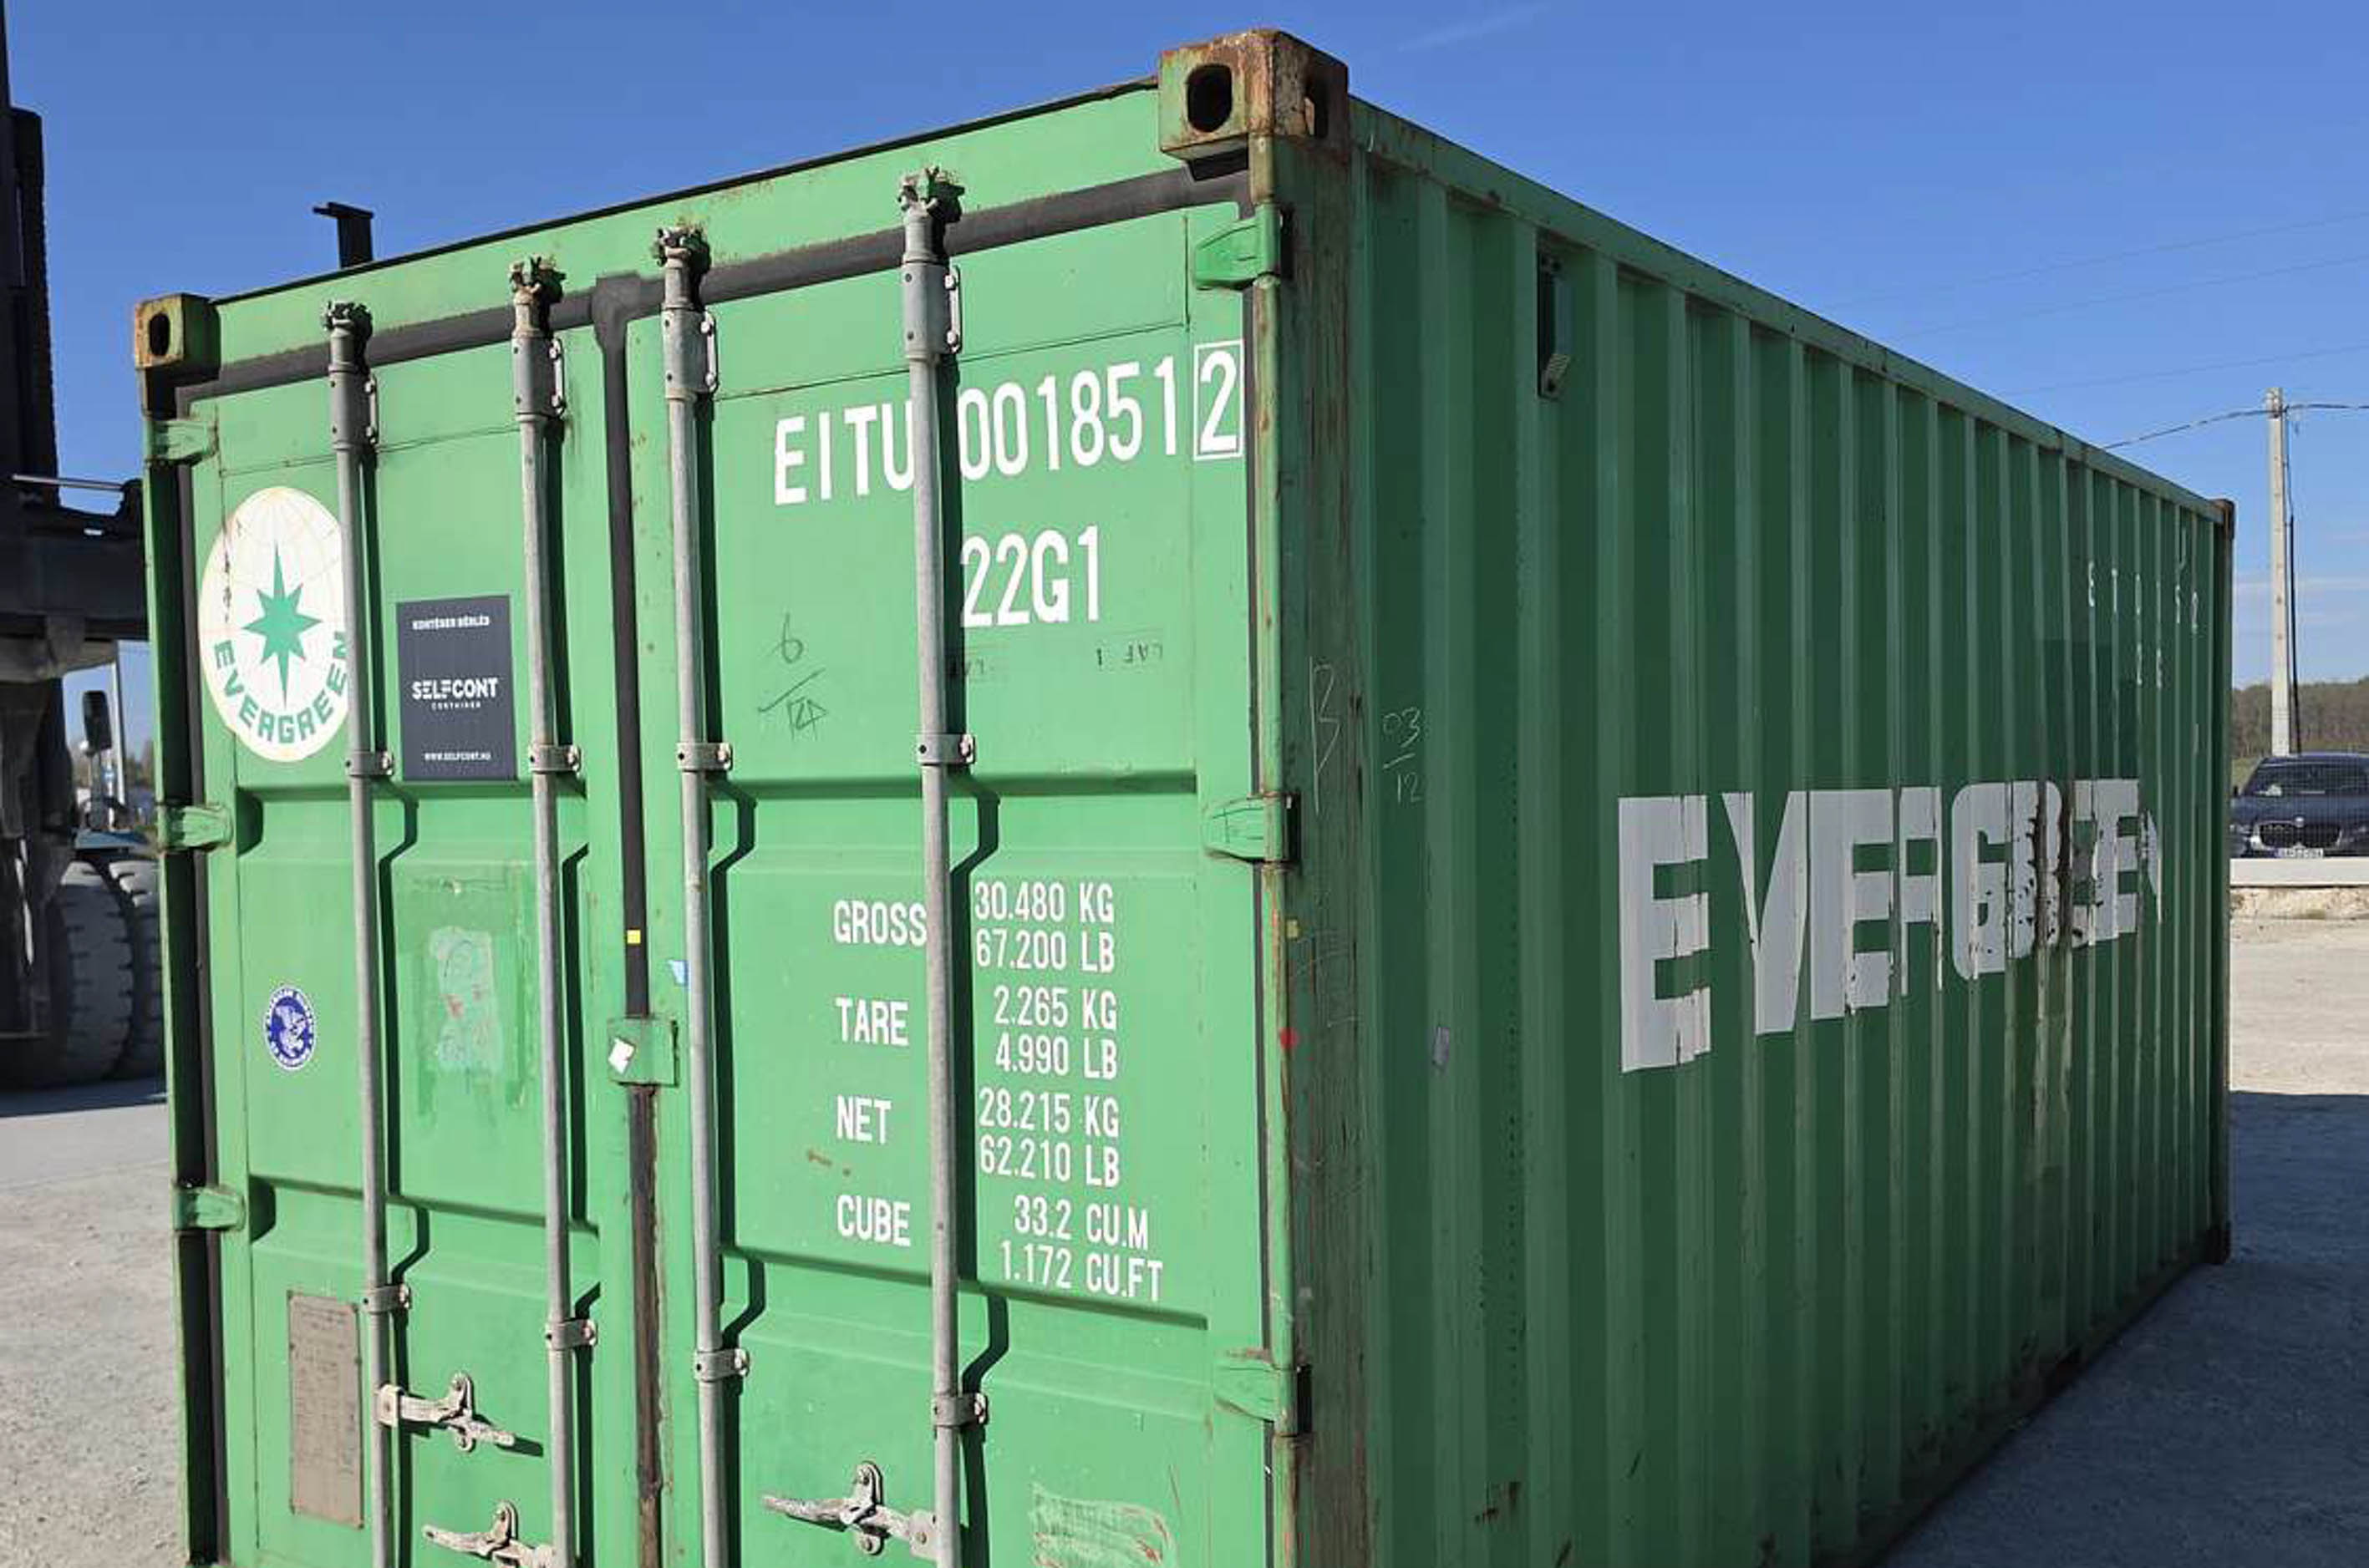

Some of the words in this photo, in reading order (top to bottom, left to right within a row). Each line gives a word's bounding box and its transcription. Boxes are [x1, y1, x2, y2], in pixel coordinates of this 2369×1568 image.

[775, 398, 915, 506] EITU
[958, 356, 1177, 480] 001851
[1200, 349, 1238, 452] 2
[960, 525, 1099, 628] 22G1
[833, 899, 927, 946] GROSS
[974, 882, 1065, 921] 30.480
[1079, 883, 1113, 923] KG
[1618, 778, 2163, 1073] EVERGEE
[976, 929, 1067, 970] 67.200
[1081, 931, 1115, 972] LB
[836, 997, 909, 1046] TARE
[994, 985, 1069, 1028] 2.265
[1082, 991, 1117, 1031] KG
[995, 1033, 1069, 1076] 4.990
[1083, 1038, 1117, 1079] LB
[836, 1095, 891, 1144] NET
[979, 1088, 1070, 1134] 28.215
[1085, 1096, 1120, 1138] KG
[980, 1135, 1071, 1181] 62.210
[1085, 1145, 1120, 1187] LB
[836, 1194, 910, 1247] CUBE
[1014, 1195, 1071, 1241] 33.2
[1086, 1204, 1148, 1251] CU.M
[1001, 1241, 1071, 1290] 1.172
[1086, 1253, 1162, 1302] CU.FT
